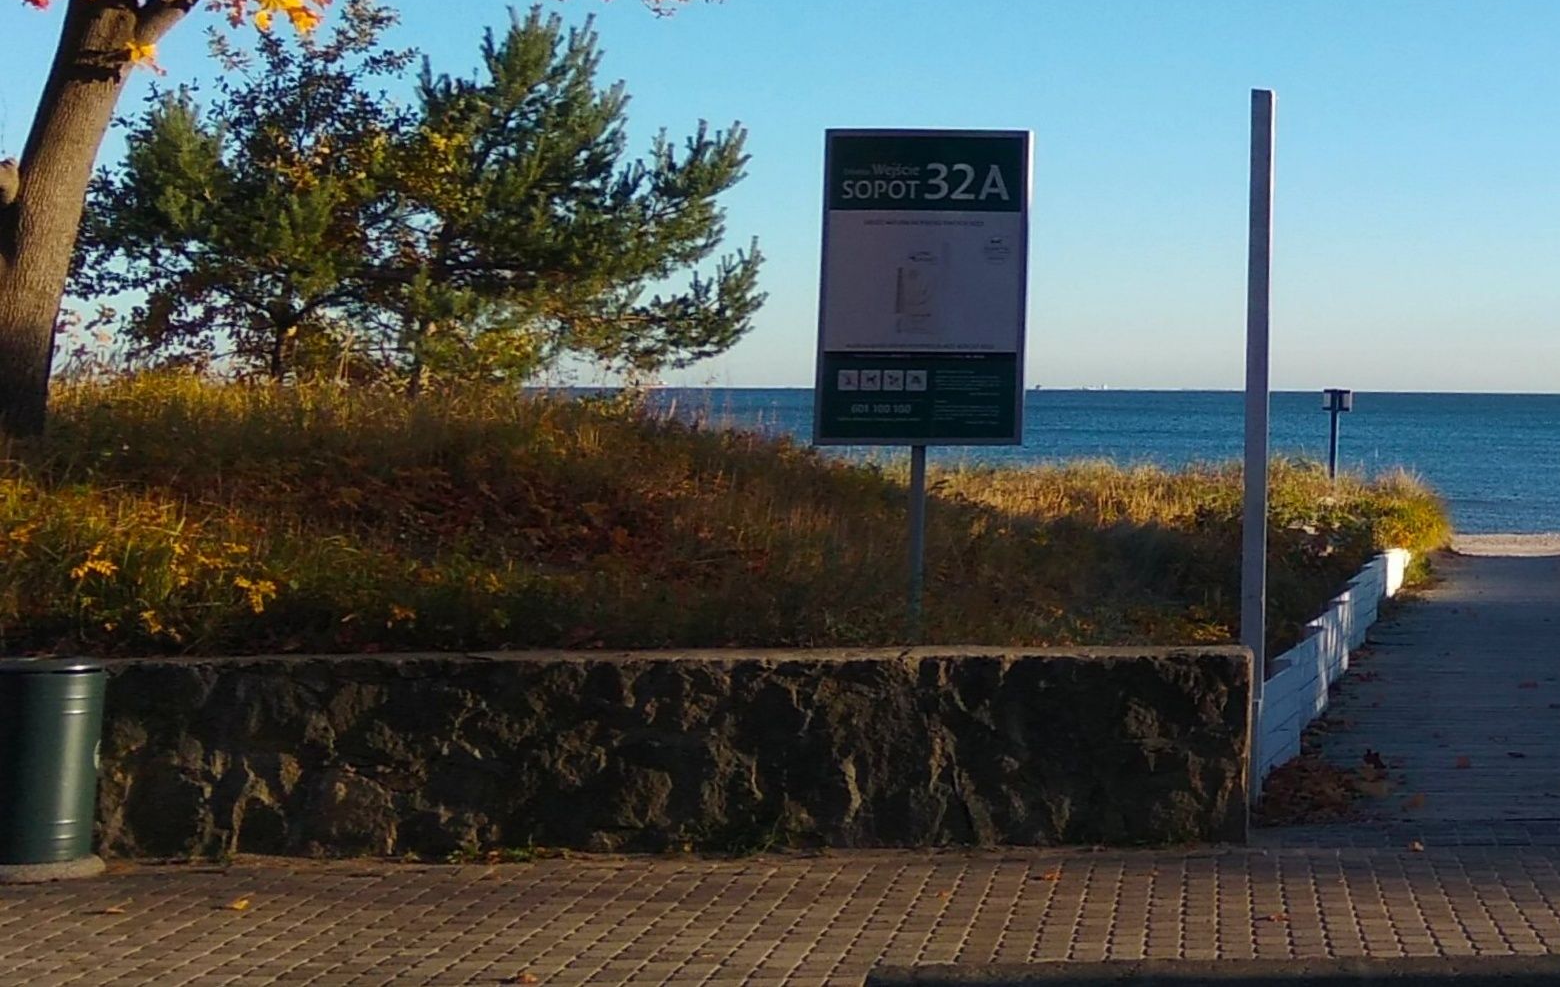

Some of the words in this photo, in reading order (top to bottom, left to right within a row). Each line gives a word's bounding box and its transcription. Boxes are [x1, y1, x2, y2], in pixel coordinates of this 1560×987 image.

[841, 180, 921, 199] SOPOT
[923, 163, 1010, 200] 32A
[850, 404, 869, 414] 601
[873, 404, 890, 414] 100
[893, 404, 911, 414] 100
